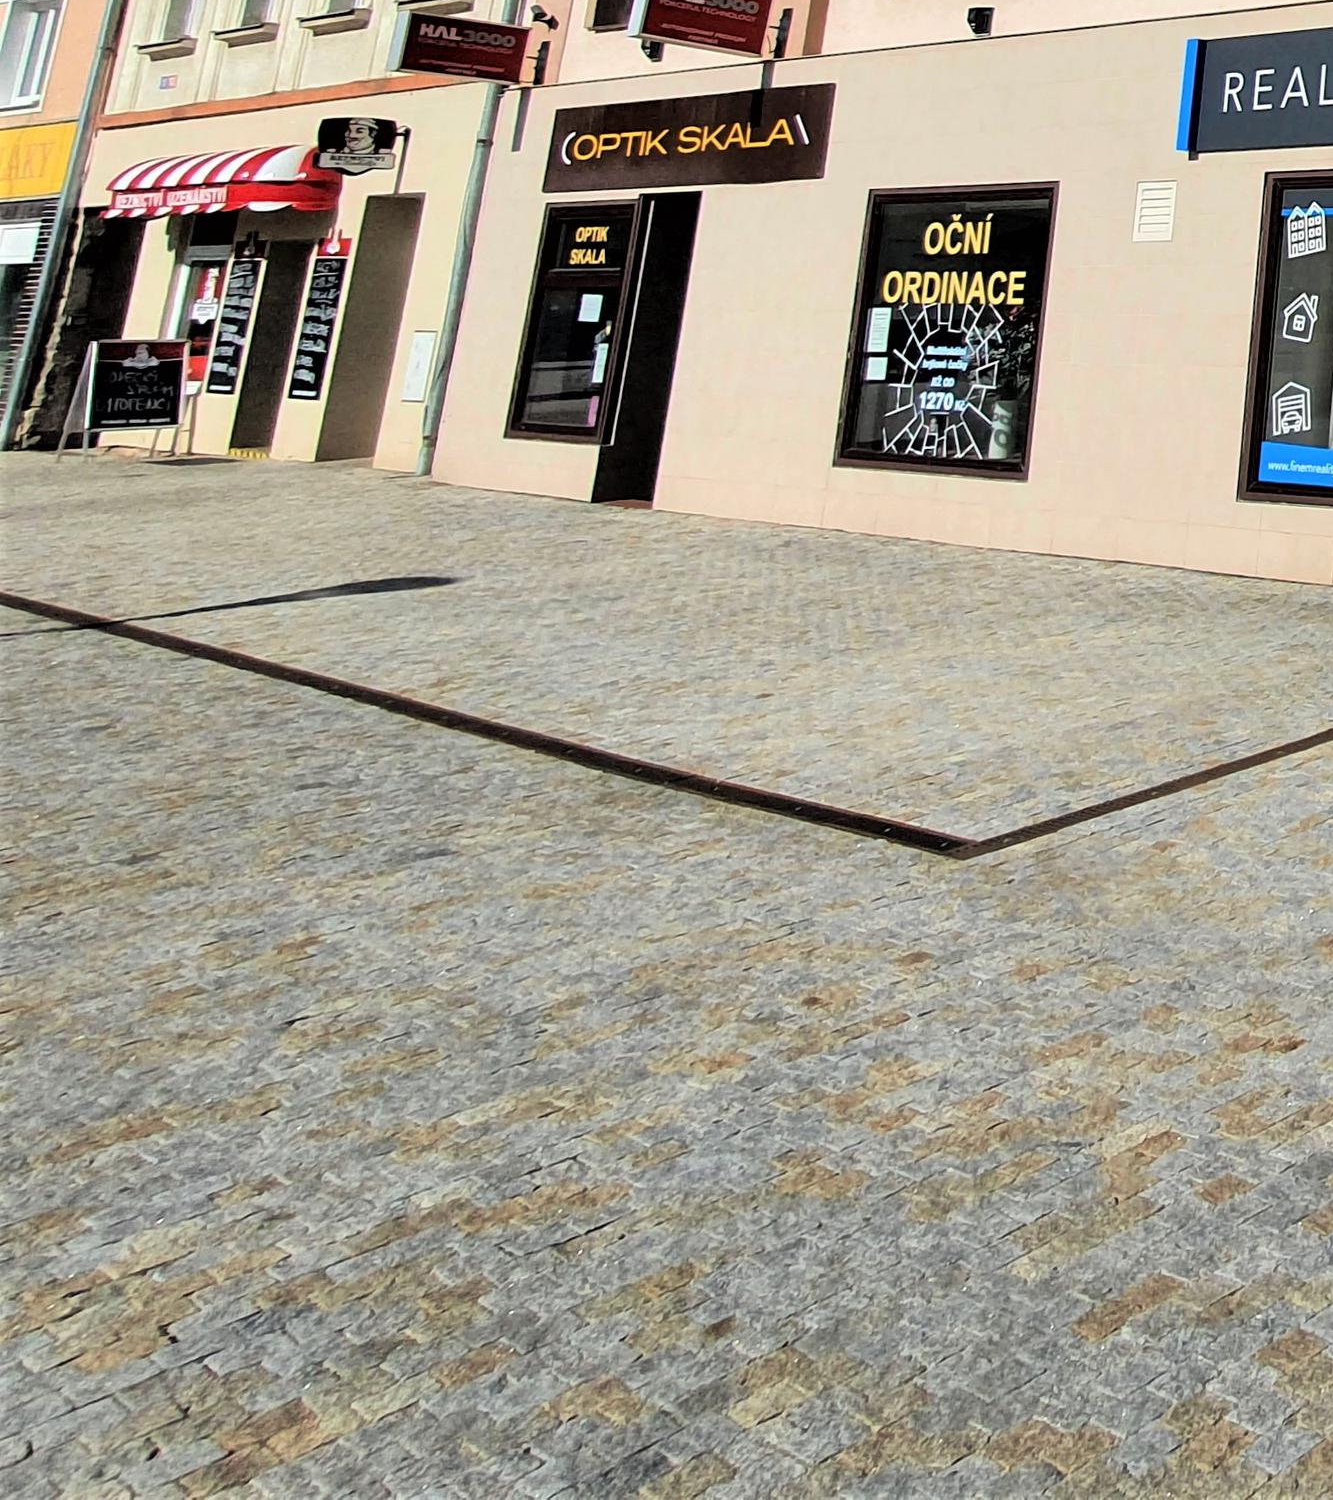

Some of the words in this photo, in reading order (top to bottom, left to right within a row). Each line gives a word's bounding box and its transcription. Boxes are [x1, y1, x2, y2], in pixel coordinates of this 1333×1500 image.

[702, 8, 758, 23] TECHNOLOGY
[574, 129, 669, 160] OPTIK
[677, 118, 795, 153] SKALA
[575, 226, 610, 242] OPTIK
[924, 213, 994, 255] OČNÍ
[569, 249, 606, 265] SKALA
[882, 270, 1026, 305] ORDINACE
[919, 392, 954, 411] 1270
